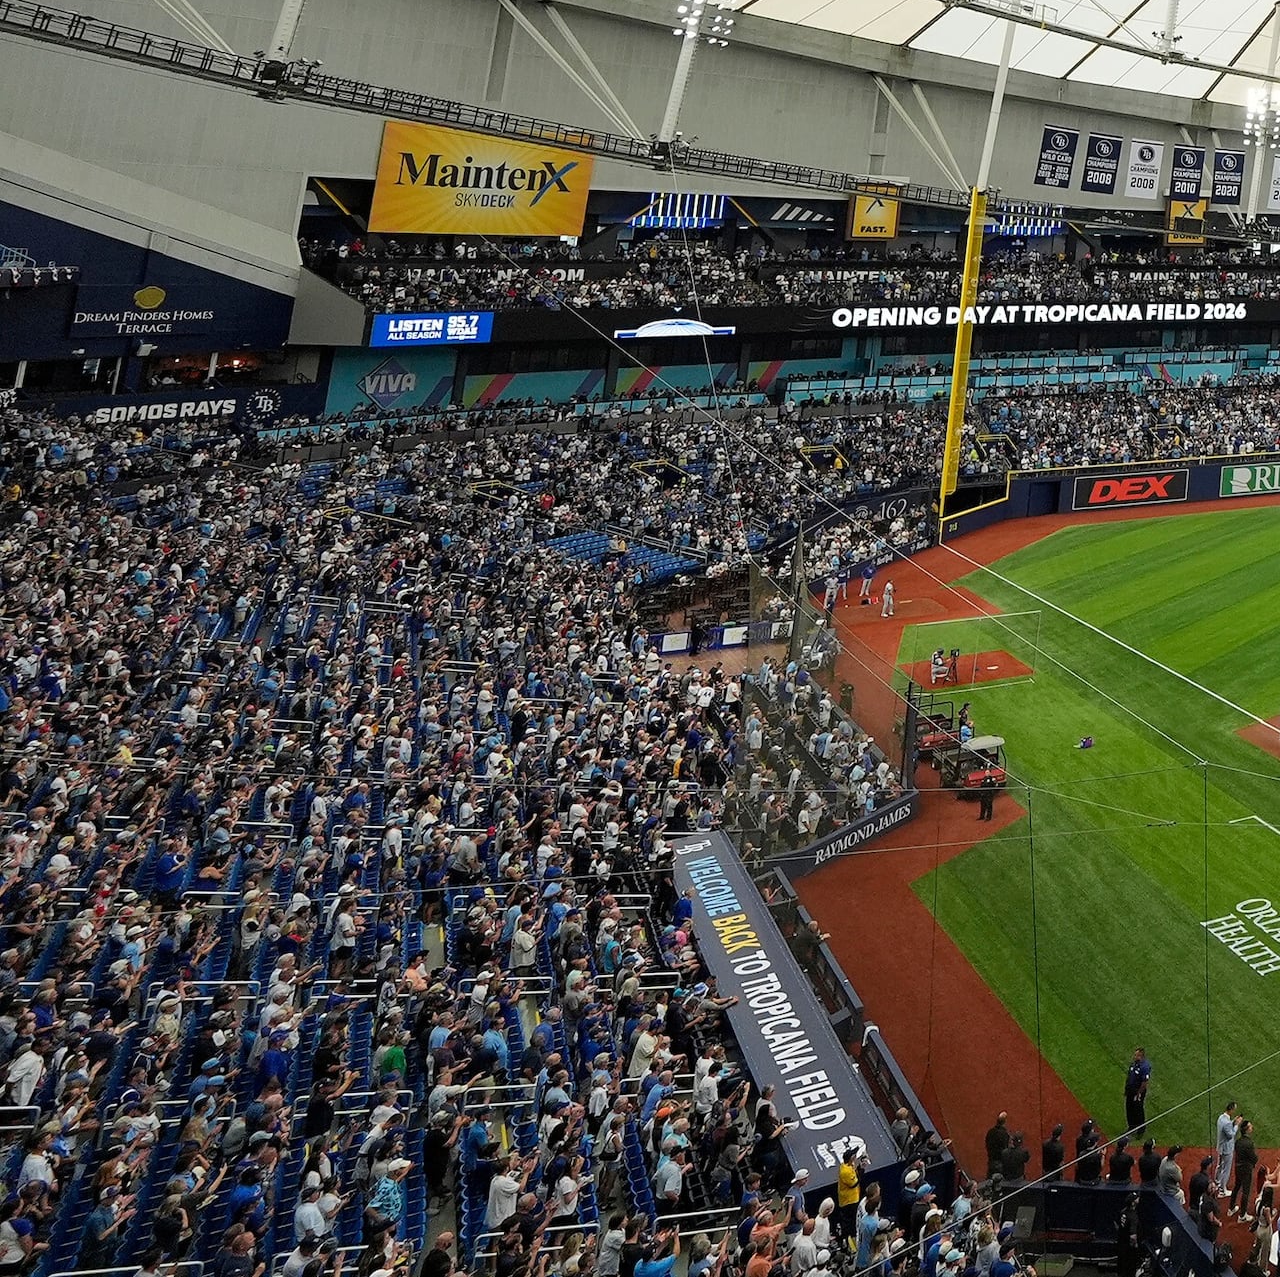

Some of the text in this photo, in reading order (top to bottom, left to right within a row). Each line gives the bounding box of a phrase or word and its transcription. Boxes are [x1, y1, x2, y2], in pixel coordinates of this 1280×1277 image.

[394, 151, 579, 208] MaintenX
[1086, 171, 1112, 184] 2008
[1130, 165, 1159, 175] CHAMPIONS
[1131, 177, 1154, 189] 2008
[1175, 182, 1196, 194] 2010
[1215, 186, 1238, 196] 2020
[455, 192, 515, 208] SKYDECK
[74, 309, 214, 324] DREAM FINDERS HOMES
[388, 315, 479, 332] LISTEN 95.7
[832, 302, 1247, 328] OPENING DAY AT TROPICANA FIELD 2026
[115, 323, 172, 334] TERRACE
[387, 332, 404, 340] ALL
[406, 331, 442, 340] SEASON
[365, 373, 416, 395] VIVA
[96, 399, 237, 425] SOMOS RAYS
[254, 395, 274, 413] TB
[1088, 475, 1175, 504] DEX
[880, 498, 907, 521] 162
[814, 803, 911, 865] RAYMOND JAMES
[686, 855, 742, 917] WELCOME
[712, 913, 761, 955] BACK
[730, 949, 773, 976] TO
[740, 973, 818, 1075] TROPICANA
[784, 1069, 847, 1132] FIELD
